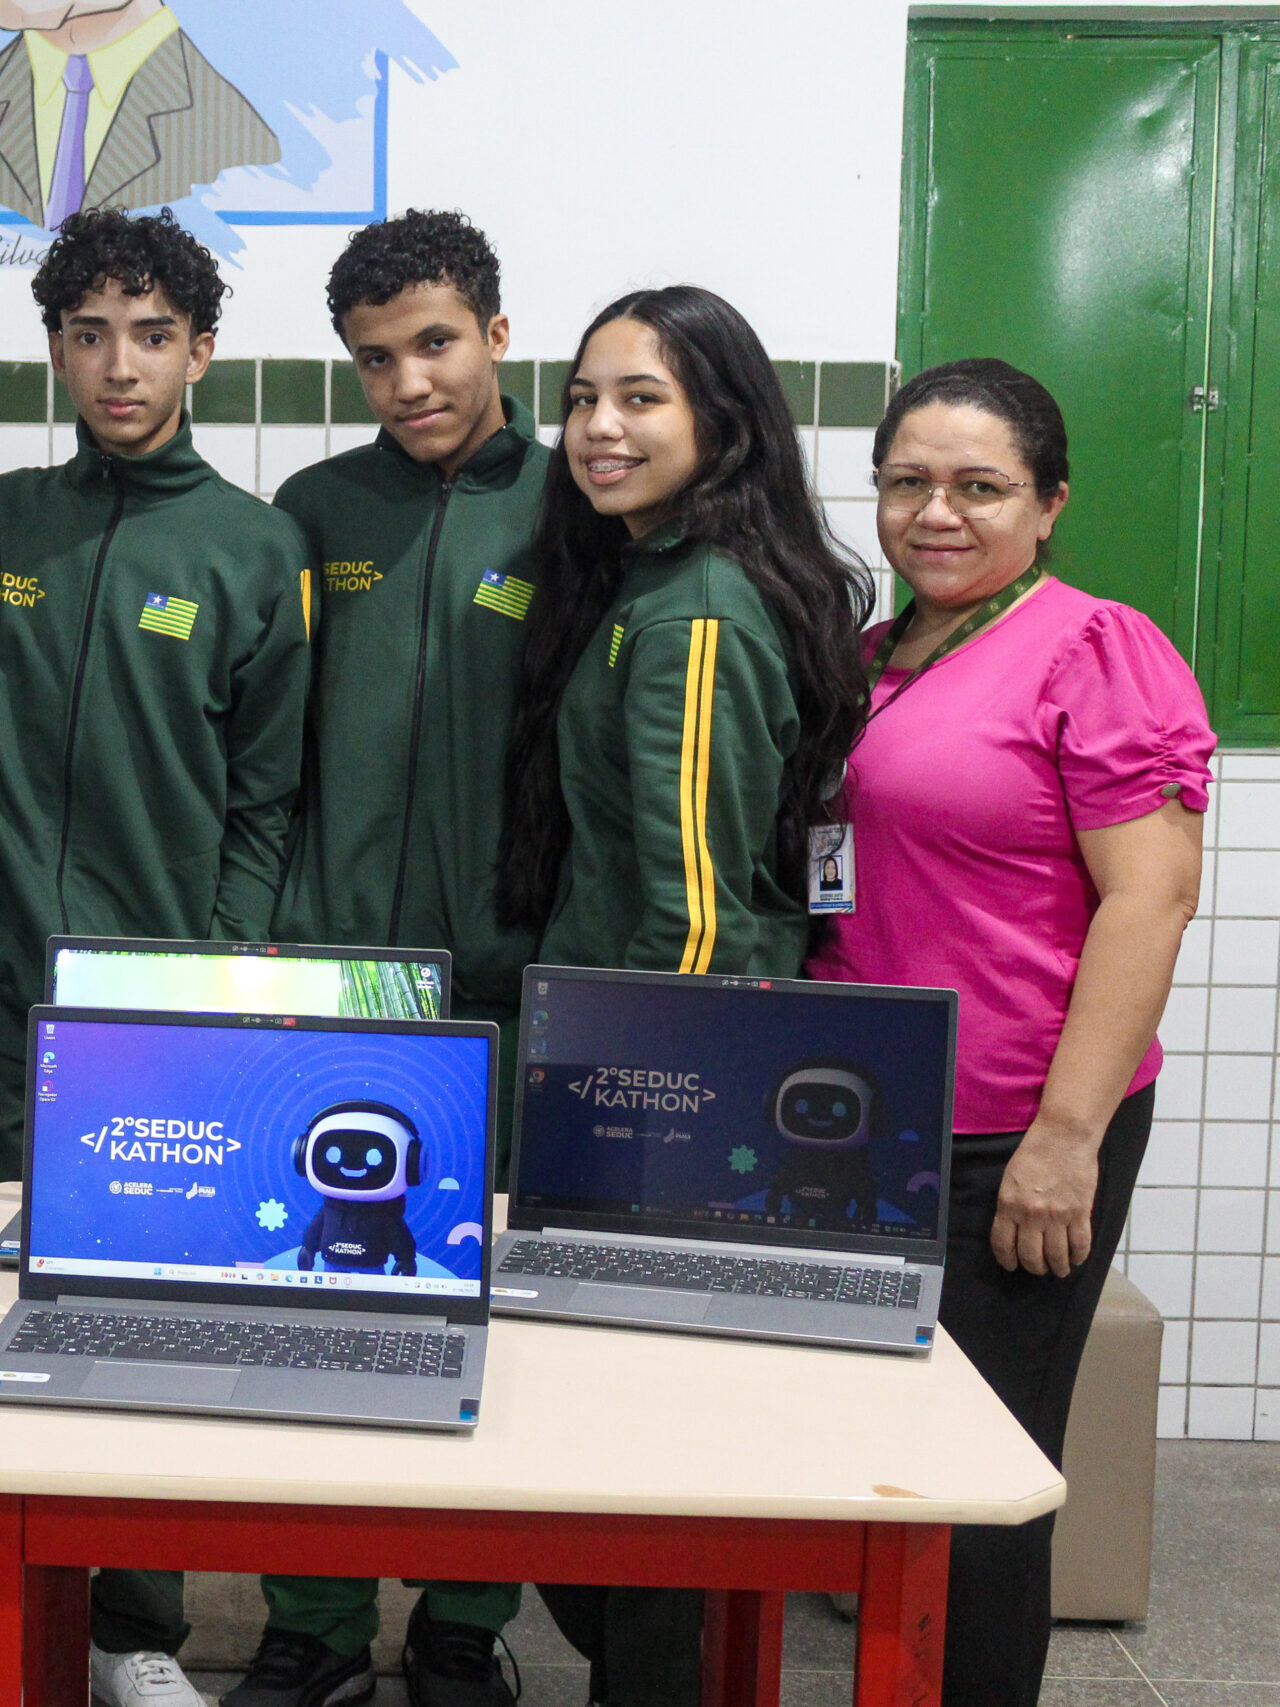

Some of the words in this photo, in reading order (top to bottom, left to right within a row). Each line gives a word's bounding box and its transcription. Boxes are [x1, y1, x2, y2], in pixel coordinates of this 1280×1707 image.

[323, 561, 374, 575] SEDUC
[594, 1088, 700, 1113] KATHON
[606, 1131, 633, 1140] SEDUC
[110, 1140, 224, 1166] KATHON
[123, 1187, 153, 1196] SEDUC
